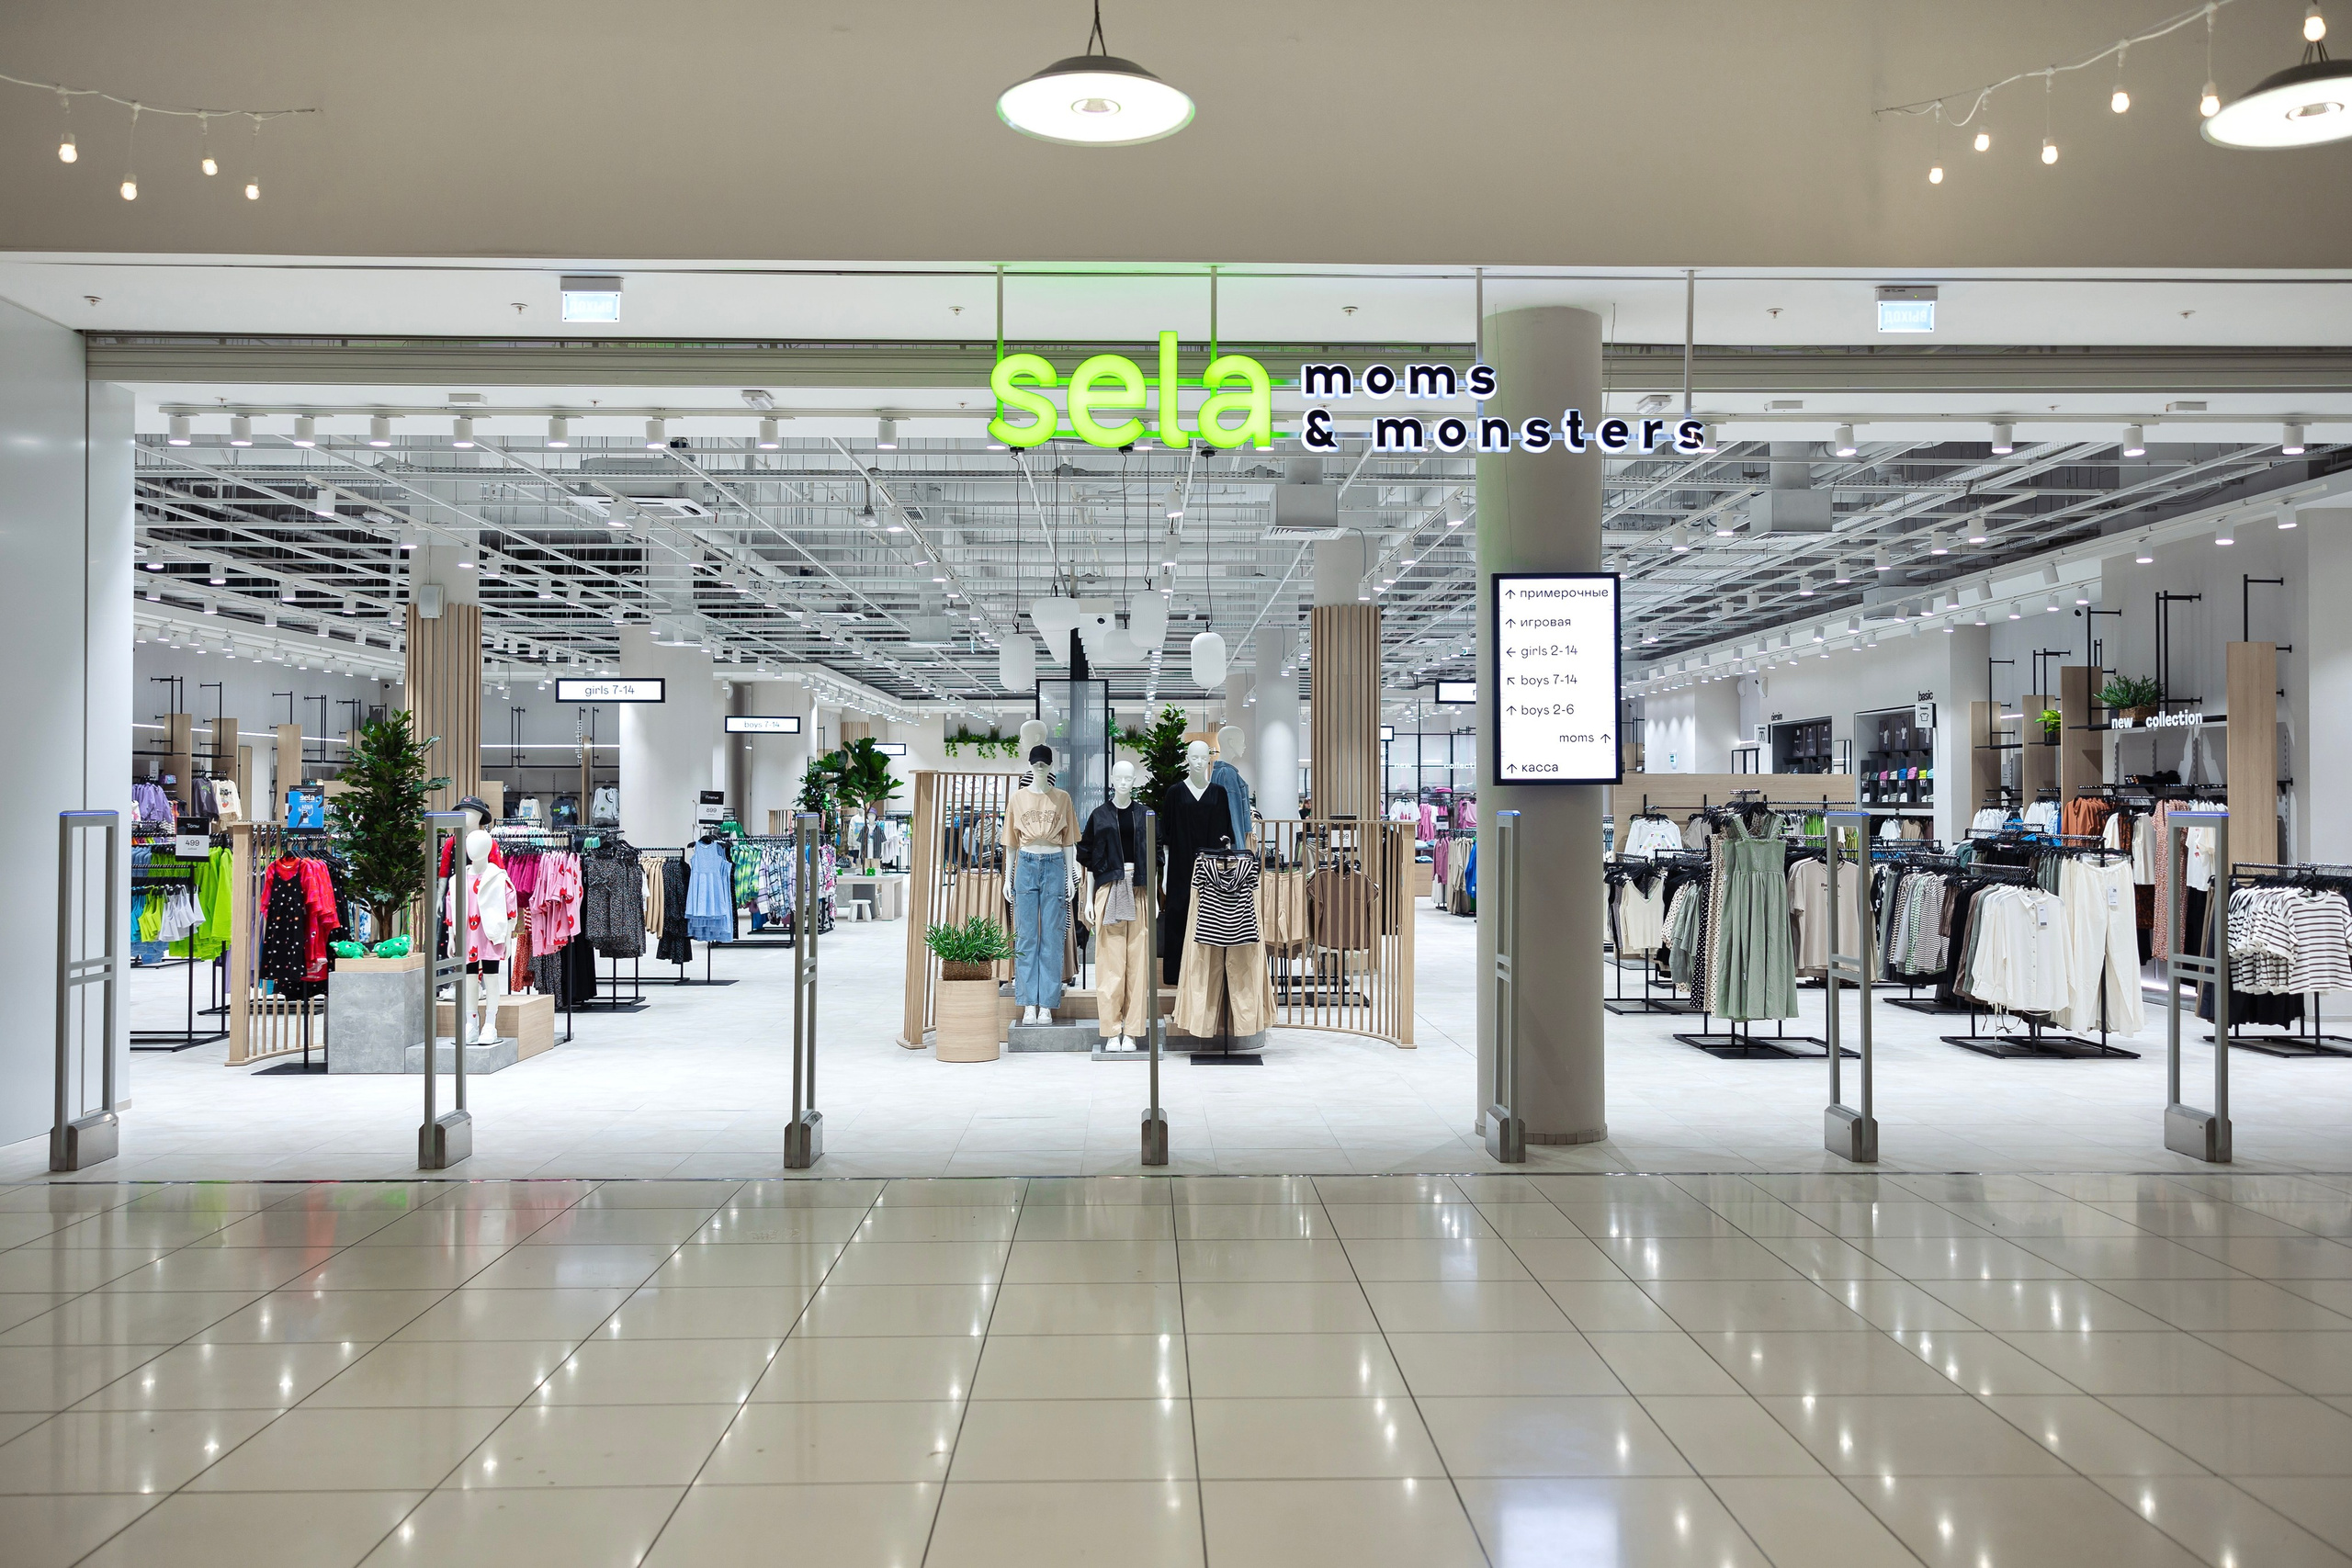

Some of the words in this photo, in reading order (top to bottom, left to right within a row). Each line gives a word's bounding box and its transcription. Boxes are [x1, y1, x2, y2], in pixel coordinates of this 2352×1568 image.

[1303, 363, 1497, 398] moms
[987, 331, 1272, 448] sela
[1304, 408, 1339, 450] &
[1374, 409, 1705, 451] monsters
[1520, 589, 1609, 600] примерочные
[1520, 618, 1571, 629] игровая
[1521, 645, 1548, 660] girls
[1550, 645, 1578, 656] 2-14
[1521, 675, 1550, 687] boys
[1553, 674, 1578, 685] 7-14
[584, 685, 609, 697] girls
[612, 685, 635, 694] 7-14
[1917, 690, 1933, 702] basic
[1521, 705, 1550, 717] boys
[1553, 704, 1575, 715] 2-6
[2111, 717, 2133, 729] new
[2145, 709, 2203, 728] collection
[1559, 734, 1595, 742] moms
[1521, 763, 1559, 773] касса
